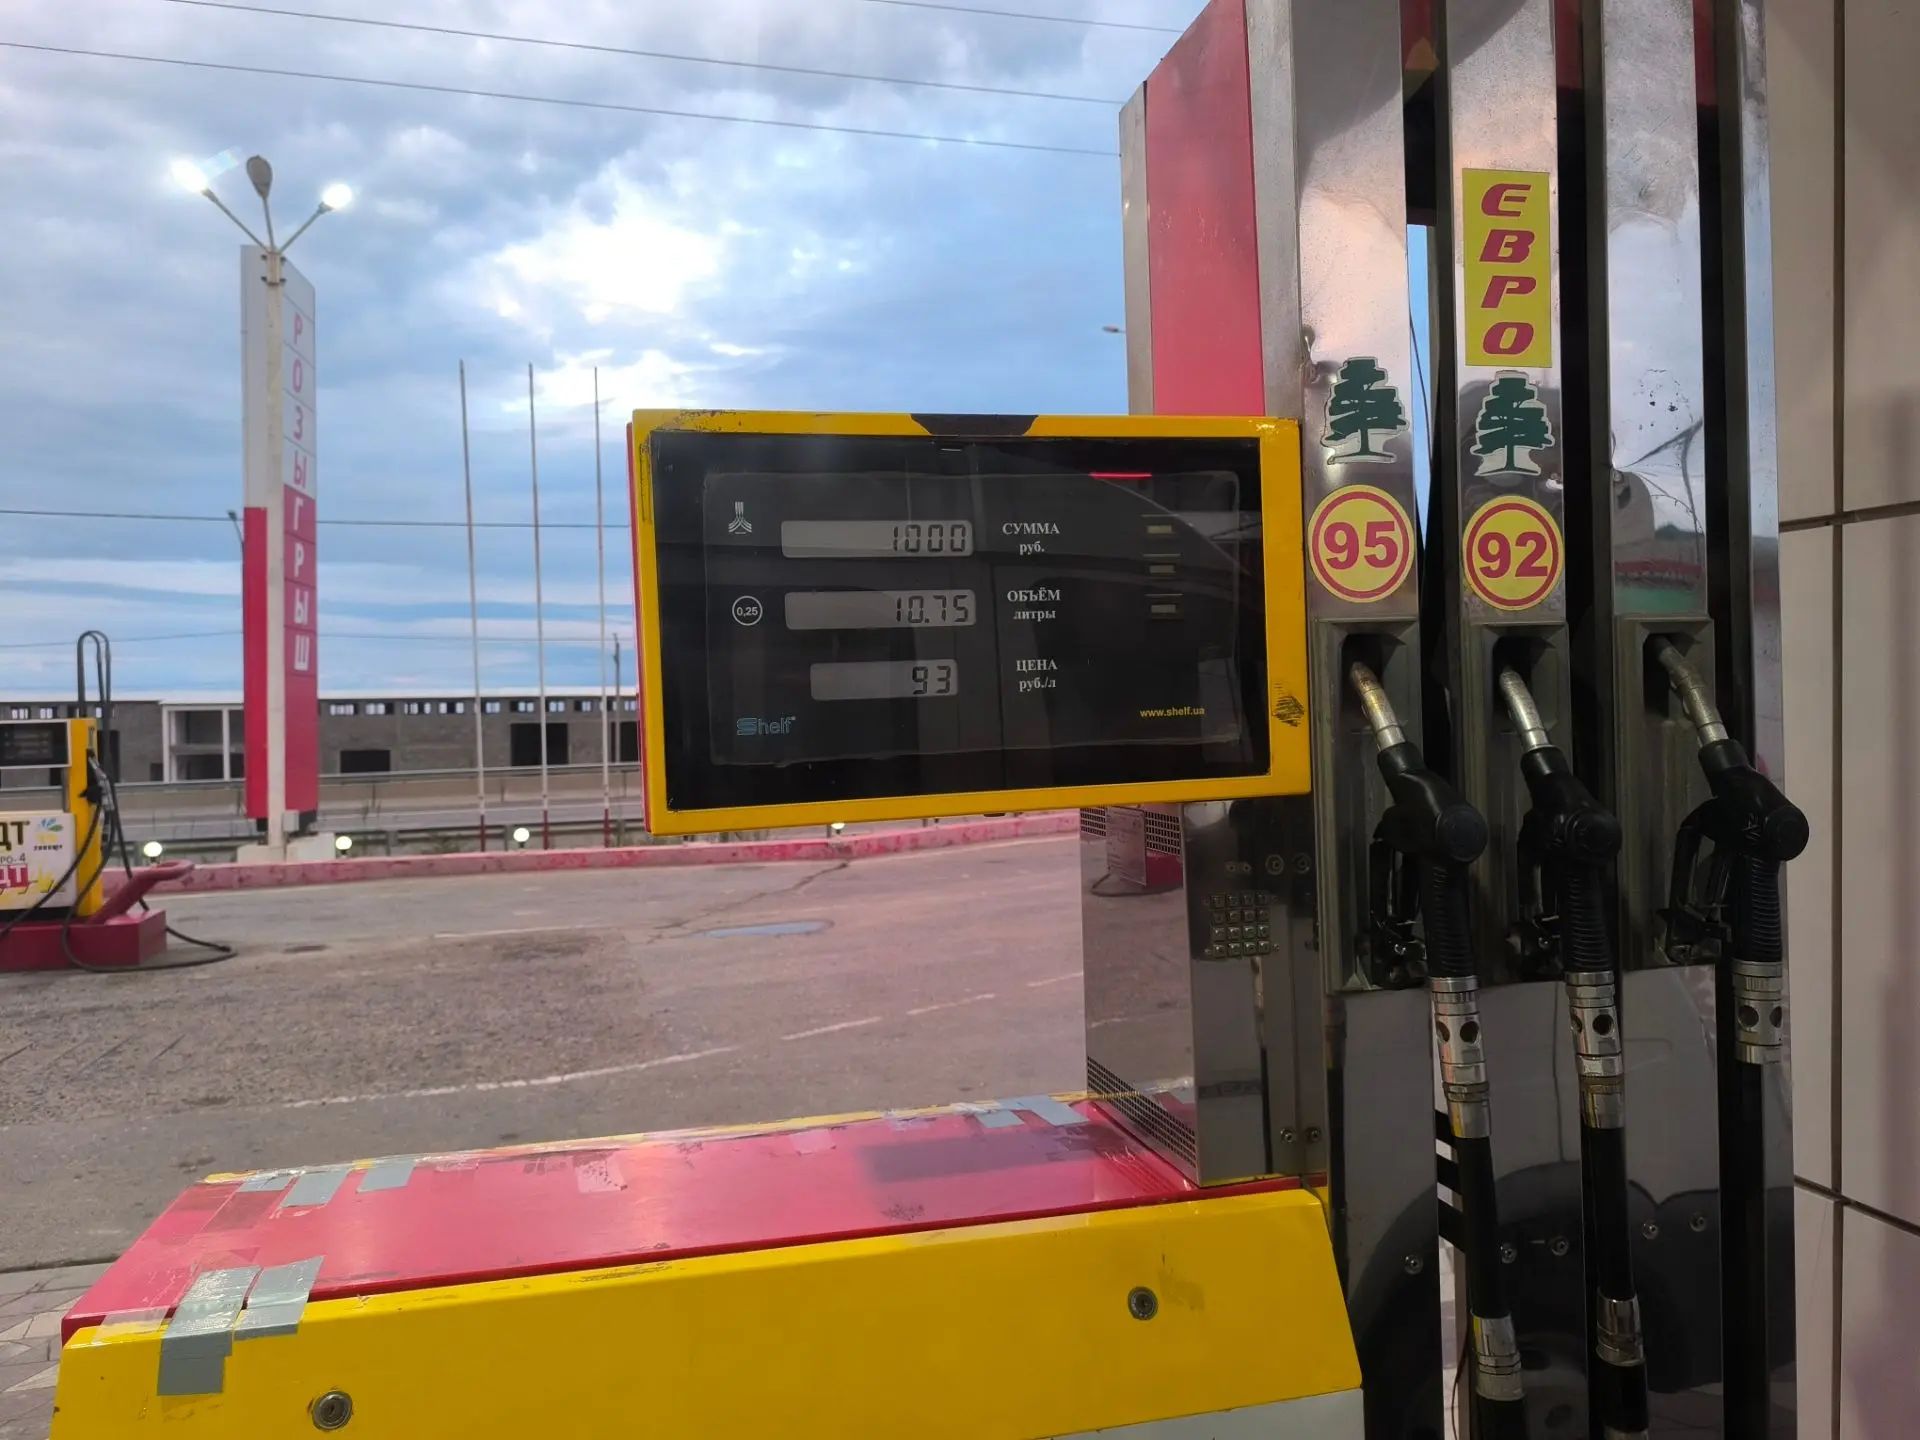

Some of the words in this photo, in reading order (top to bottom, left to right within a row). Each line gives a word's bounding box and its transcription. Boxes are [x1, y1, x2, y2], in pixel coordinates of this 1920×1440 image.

[1479, 182, 1537, 356] ЕВРО
[292, 311, 310, 672] РОЗЫГРЫШ
[1001, 522, 1061, 535] СУММА
[893, 523, 967, 553] 1000
[1322, 520, 1400, 572] 95
[1018, 540, 1046, 555] руб.
[1476, 531, 1550, 579] 92
[1006, 586, 1062, 602] ОБЪЁМ
[736, 605, 759, 617] 0,25
[895, 594, 969, 624] 10.75
[1012, 608, 1057, 622] литры
[1015, 658, 1059, 672] ЦЕНА
[911, 665, 952, 695] 93
[1018, 676, 1057, 692] руб./л
[1139, 706, 1206, 718] www.shelf.ua
[736, 716, 793, 736] Shelf
